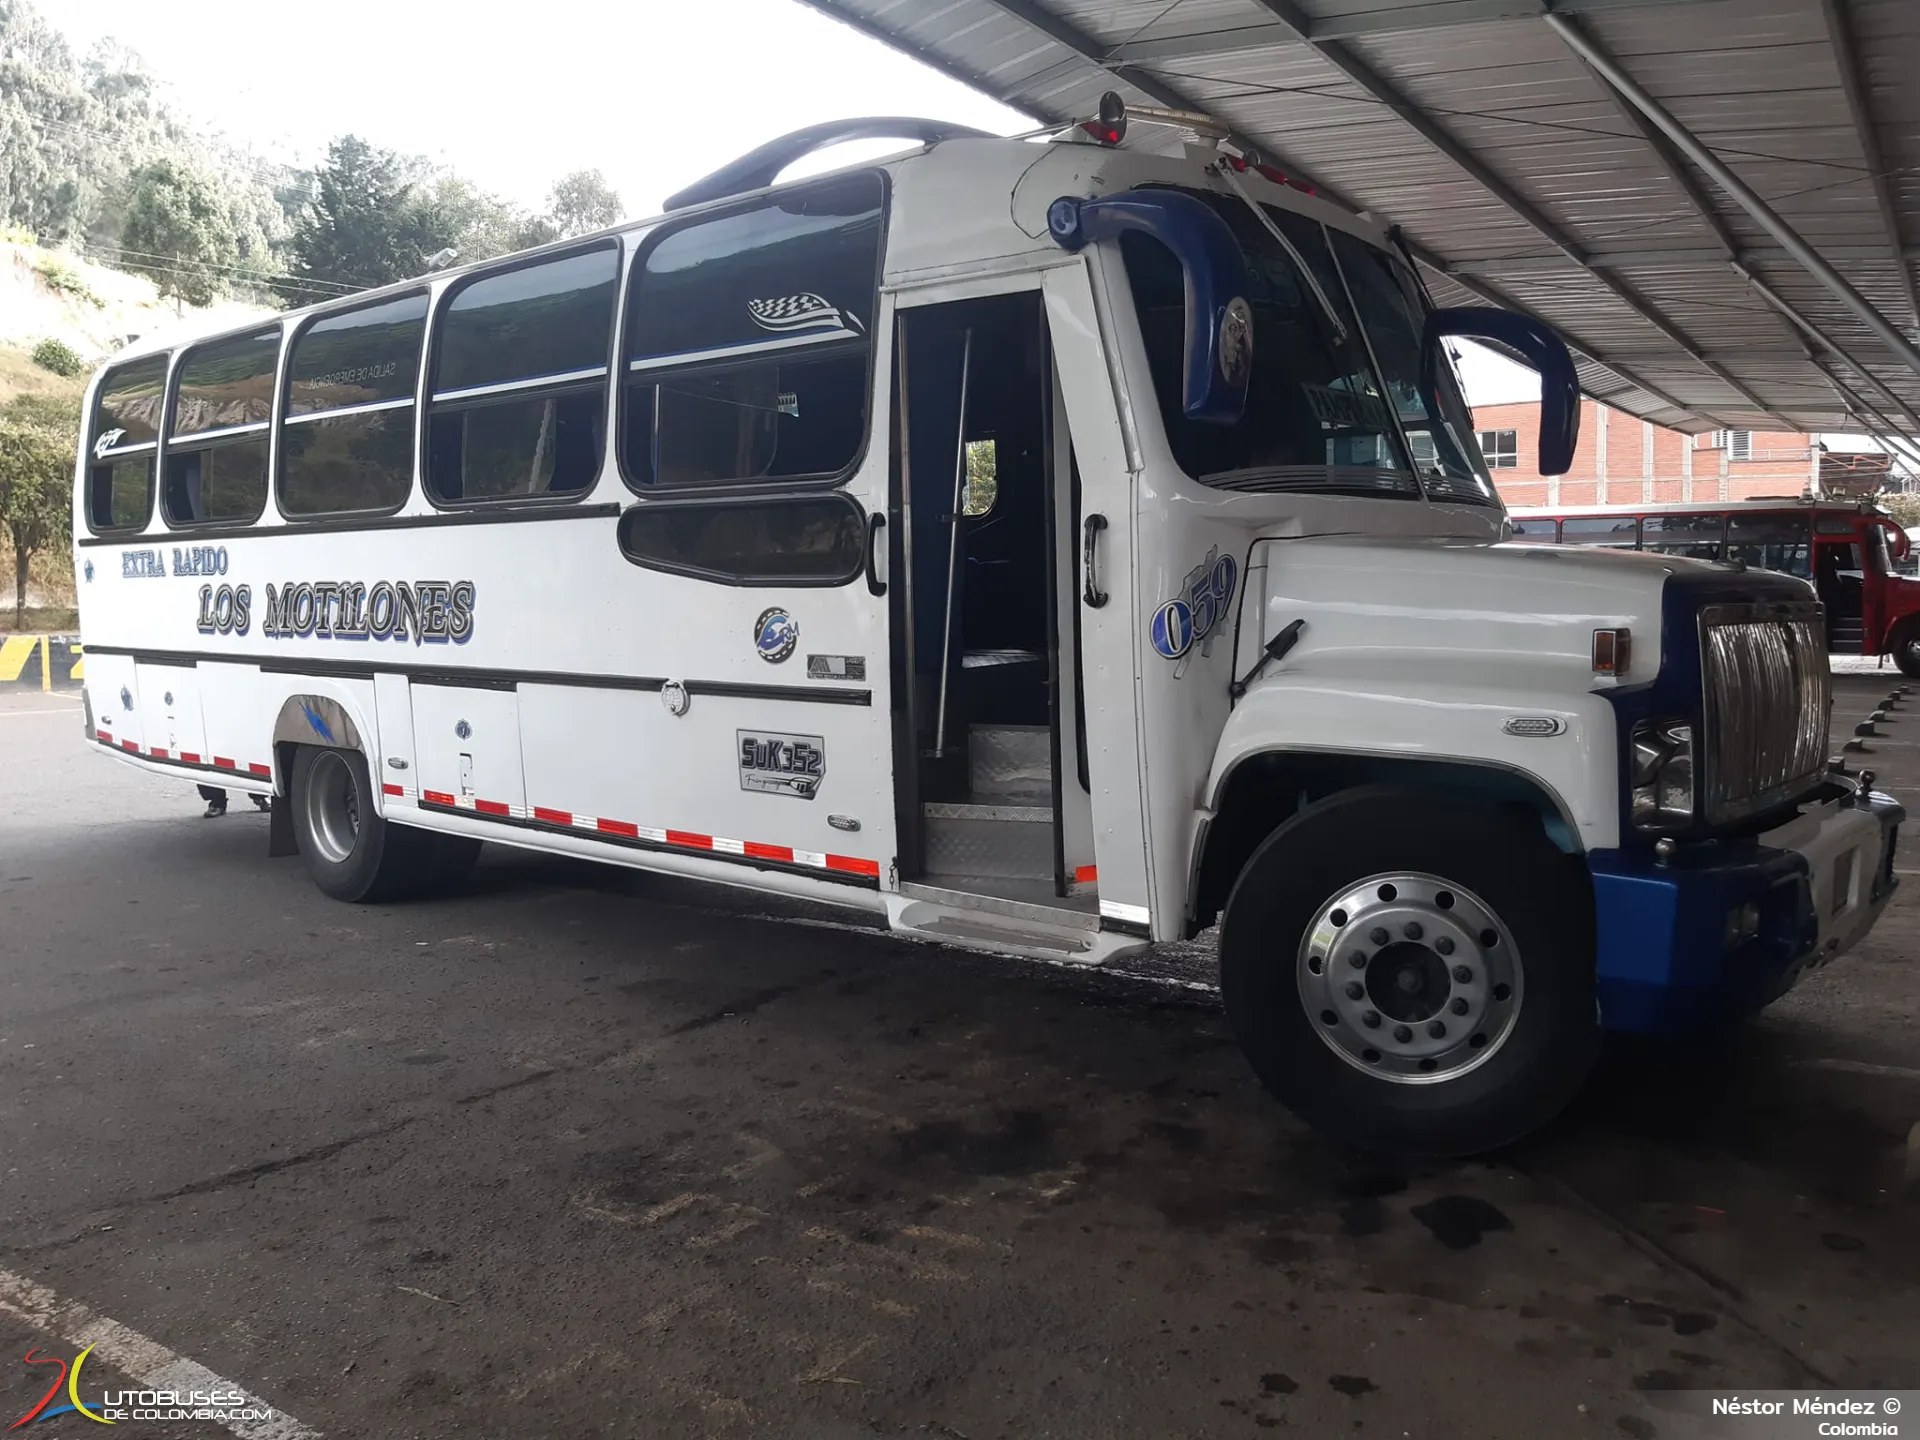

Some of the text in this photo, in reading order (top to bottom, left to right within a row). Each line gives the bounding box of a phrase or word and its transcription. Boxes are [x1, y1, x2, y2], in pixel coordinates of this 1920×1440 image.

[122, 546, 229, 578] EXTRA RAPIDO
[197, 580, 476, 647] LOS MOTILONES
[1150, 553, 1237, 660] 059
